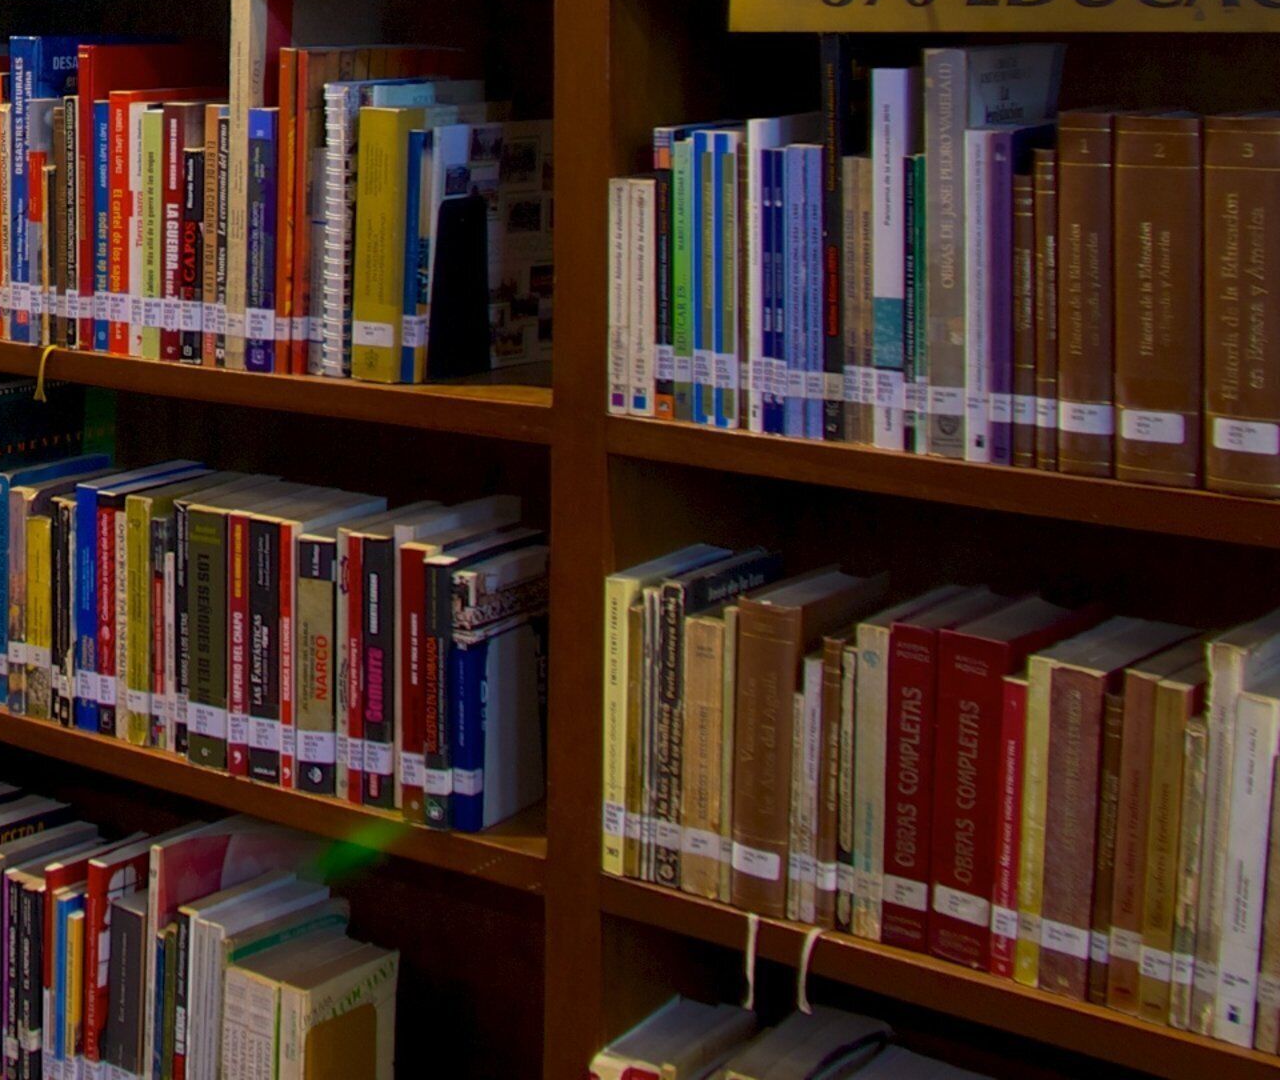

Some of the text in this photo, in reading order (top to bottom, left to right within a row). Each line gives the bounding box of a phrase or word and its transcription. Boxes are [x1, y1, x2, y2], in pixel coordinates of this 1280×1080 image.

[53, 56, 78, 70] DESA
[939, 134, 954, 180] PEDRO
[96, 212, 107, 239] sapos
[111, 189, 122, 292] El cartel de los sapos
[166, 203, 179, 269] LA GUERRA
[940, 219, 955, 239] DE
[184, 221, 196, 282] CAPOS
[940, 243, 956, 288] OBRAS
[198, 553, 209, 582] LOS
[233, 611, 242, 643] CHAPO
[198, 659, 210, 684] DEL
[233, 645, 242, 662] DEL
[315, 635, 327, 701] NARCO
[894, 687, 922, 867] OBRAS COMPLETAS
[953, 700, 979, 885] OBRAS COMPLETAS
